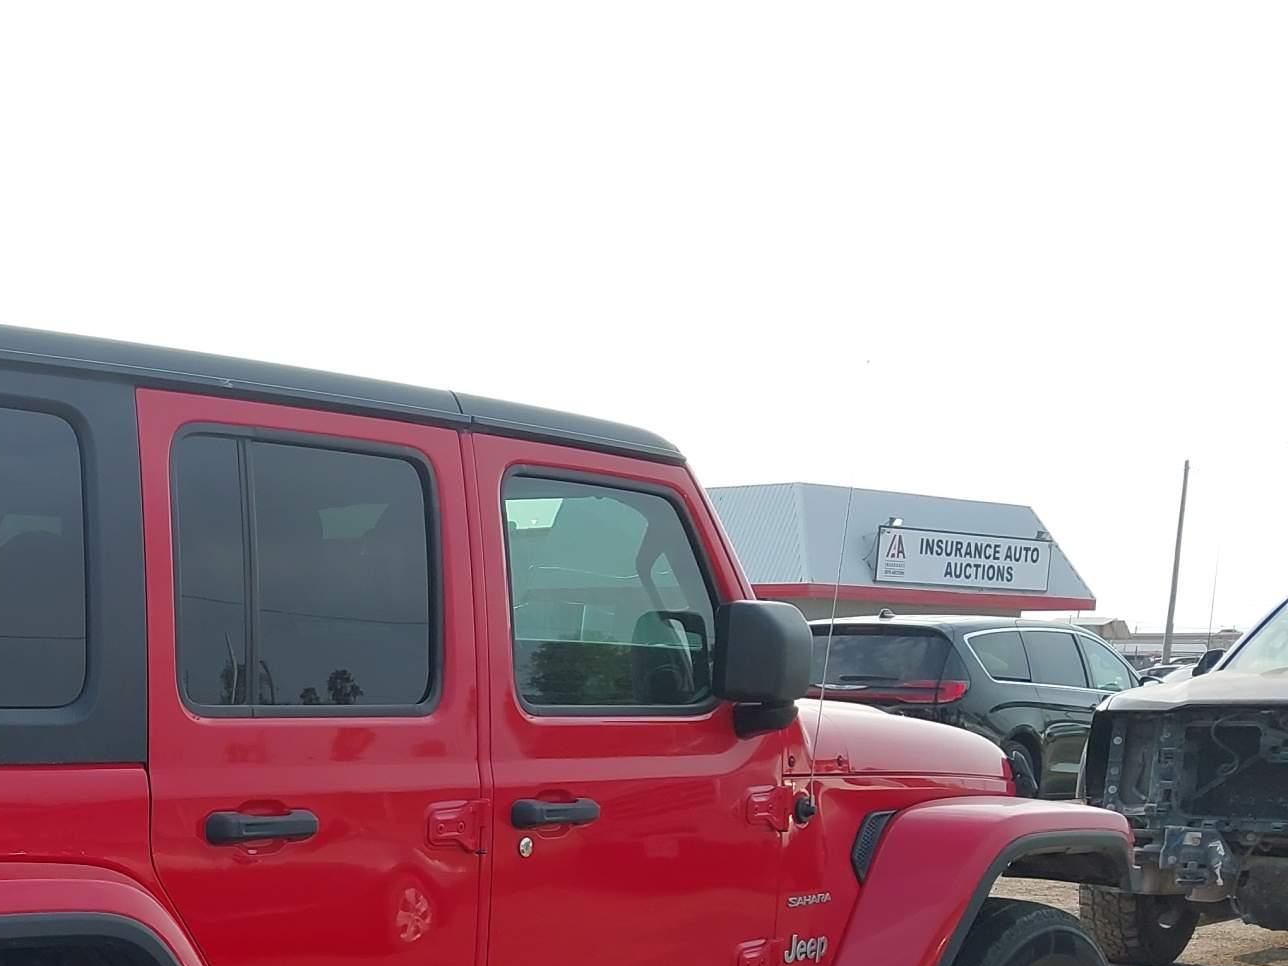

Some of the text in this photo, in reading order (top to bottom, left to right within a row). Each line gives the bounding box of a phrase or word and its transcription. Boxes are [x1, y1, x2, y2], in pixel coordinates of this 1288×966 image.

[919, 537, 1040, 564] INSURANCE AUTO
[944, 562, 1014, 583] AUCTIONS
[787, 892, 832, 908] SAHARA
[784, 934, 828, 964] Jeep
